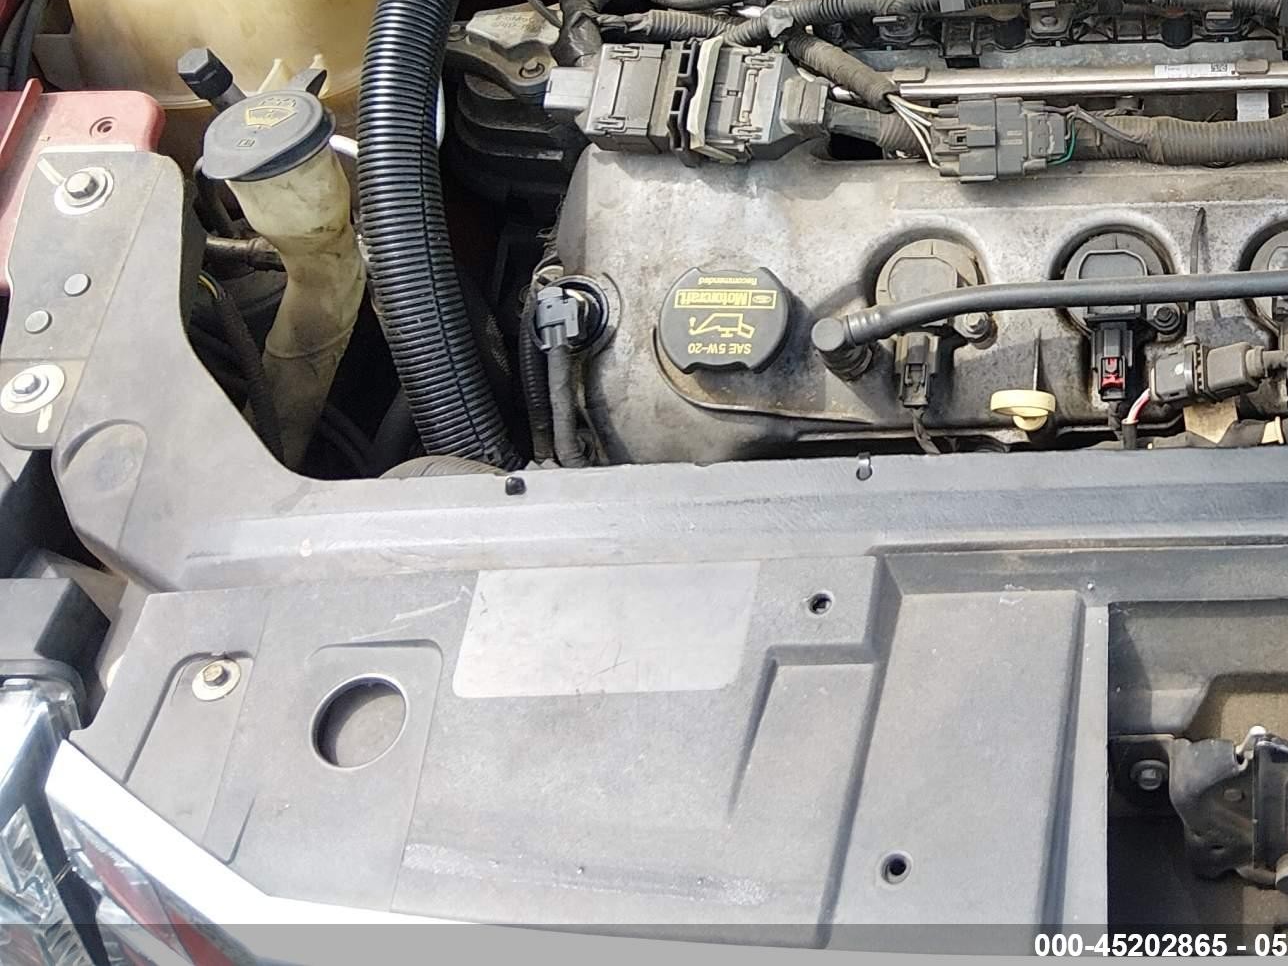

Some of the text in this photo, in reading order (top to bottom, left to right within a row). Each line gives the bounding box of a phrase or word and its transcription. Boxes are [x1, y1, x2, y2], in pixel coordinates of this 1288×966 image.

[698, 276, 758, 286] Recommended
[679, 291, 748, 306] Motorcraft
[687, 343, 752, 355] SAE 5W-20
